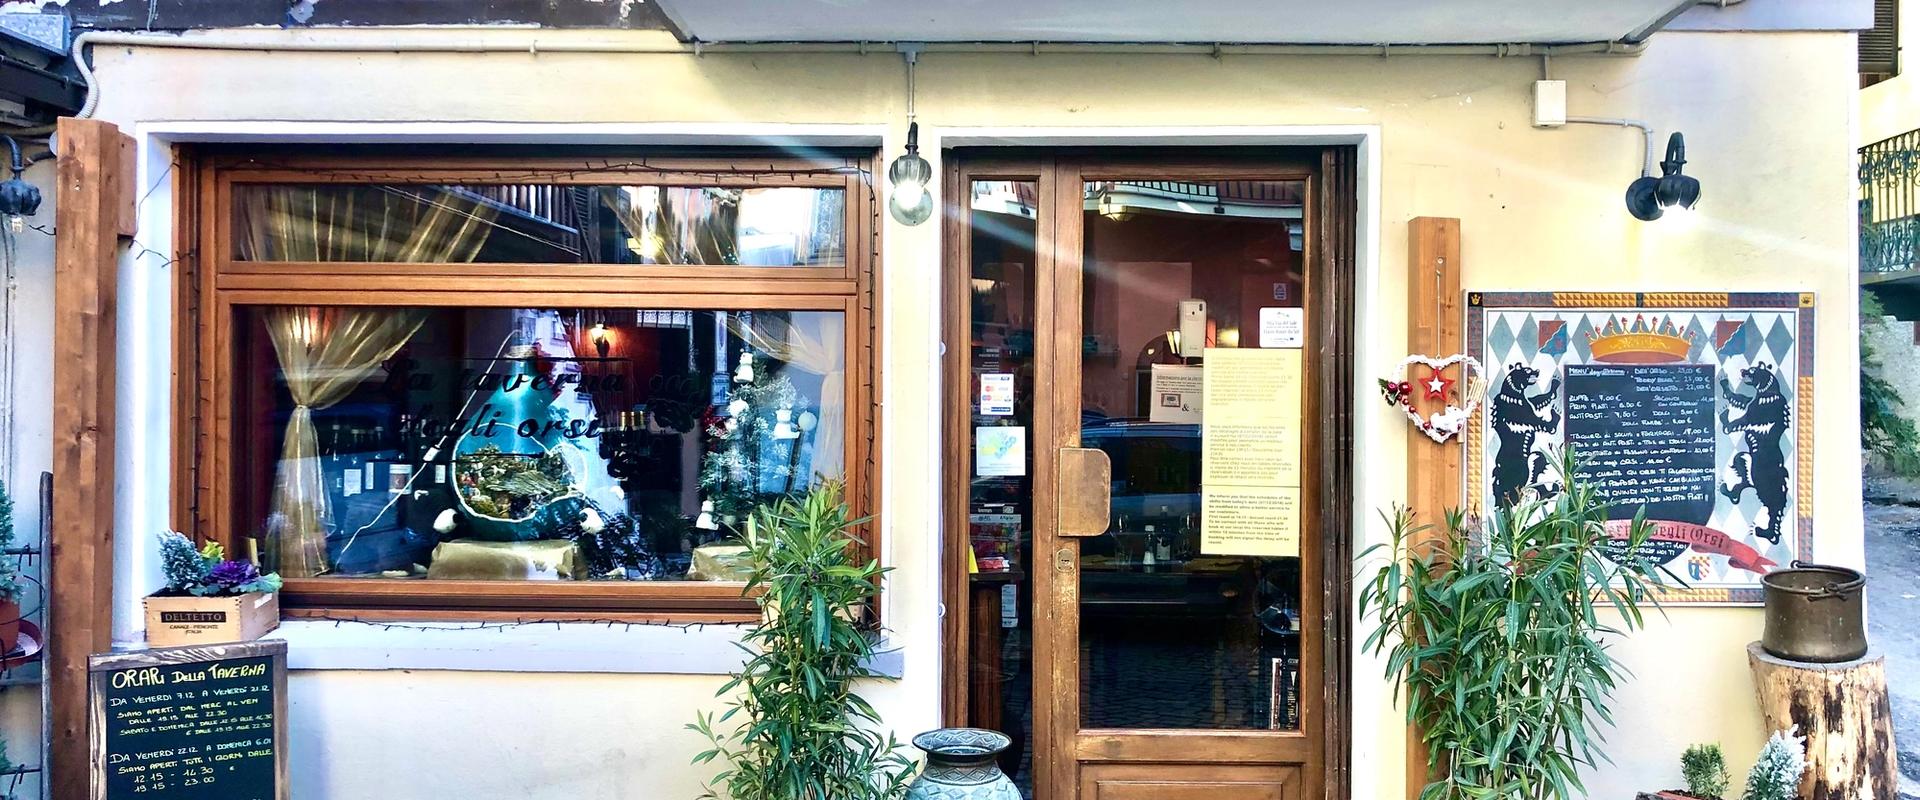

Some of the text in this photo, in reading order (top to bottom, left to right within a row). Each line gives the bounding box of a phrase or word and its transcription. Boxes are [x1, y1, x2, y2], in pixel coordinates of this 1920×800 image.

[459, 364, 625, 393] taverna
[399, 402, 601, 439] degli orsi
[1690, 527, 1726, 548] Orsi
[165, 613, 222, 621] DELTETTO
[171, 671, 206, 684] DELLA
[208, 663, 266, 680] TAVERNA
[109, 698, 128, 707] DA
[117, 711, 143, 719] SIAMO
[120, 727, 150, 736] SABATO
[109, 754, 131, 764] DA
[118, 766, 146, 774] SIAMO
[248, 749, 273, 757] DALLE
